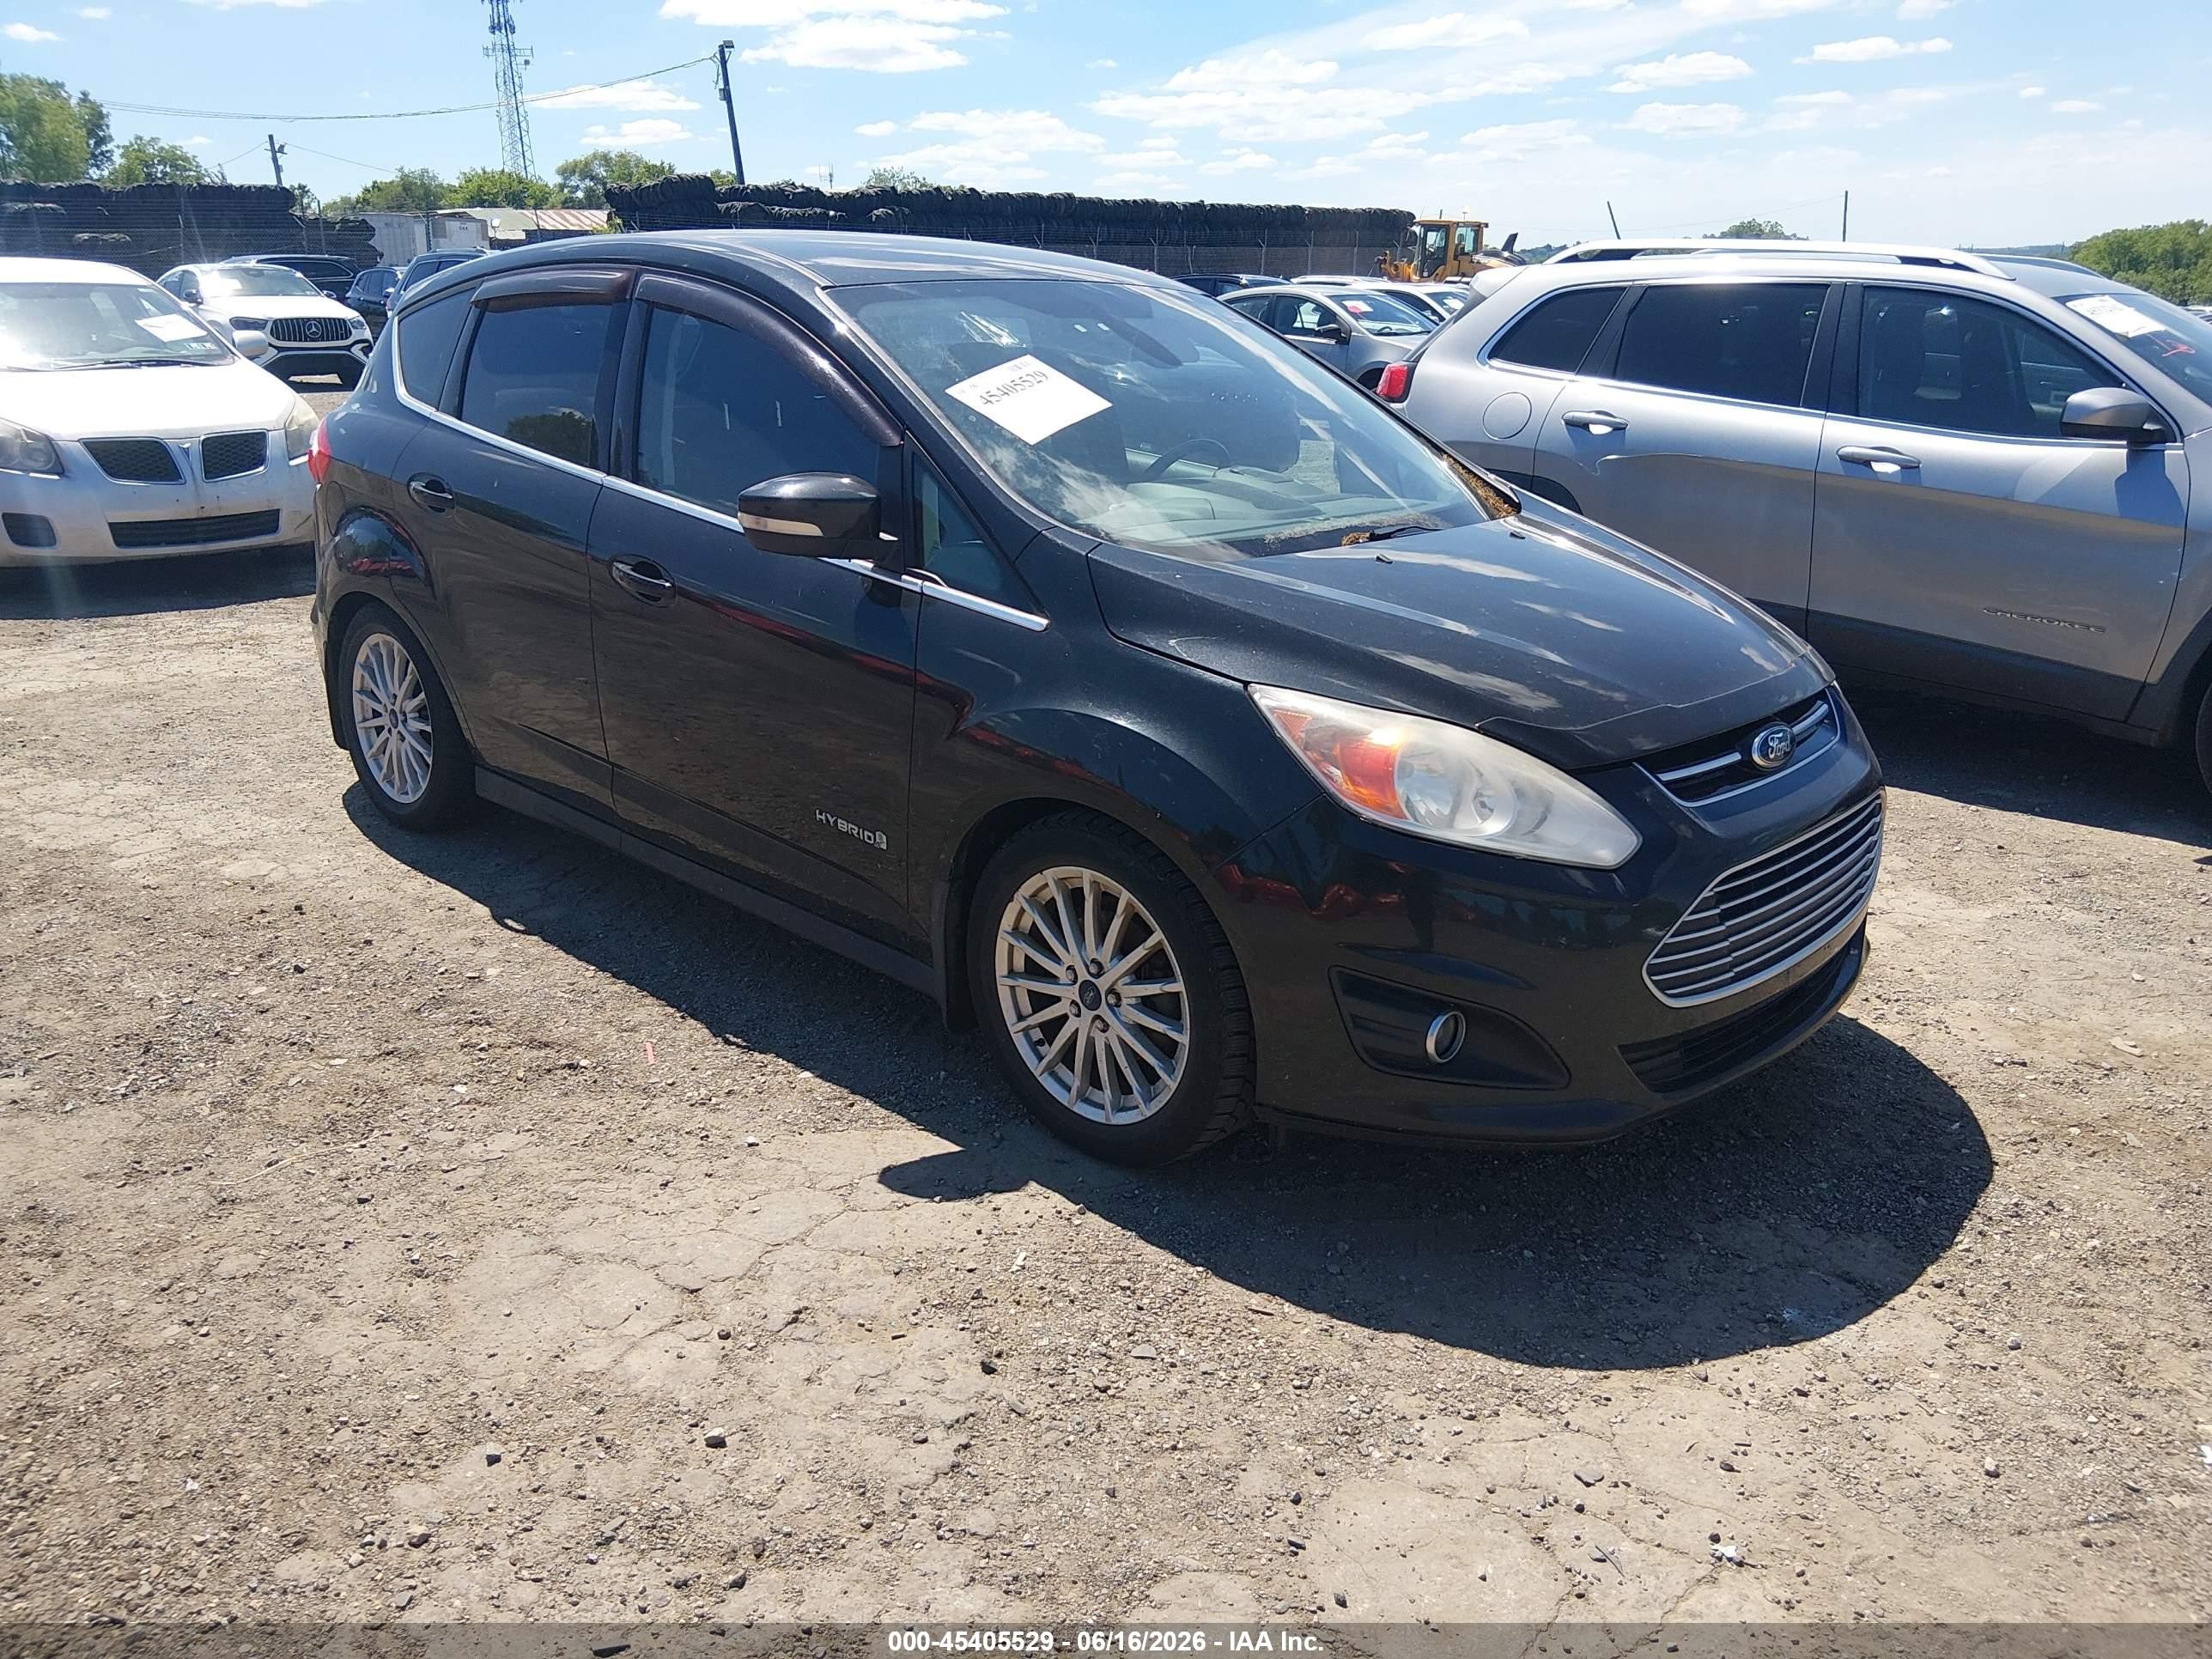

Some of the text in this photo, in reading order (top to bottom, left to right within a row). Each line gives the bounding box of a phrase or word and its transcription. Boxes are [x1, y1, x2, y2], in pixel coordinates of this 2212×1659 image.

[979, 370, 1048, 405] 45405529
[1768, 732, 1792, 758] Ford
[815, 809, 874, 844] HYBRID
